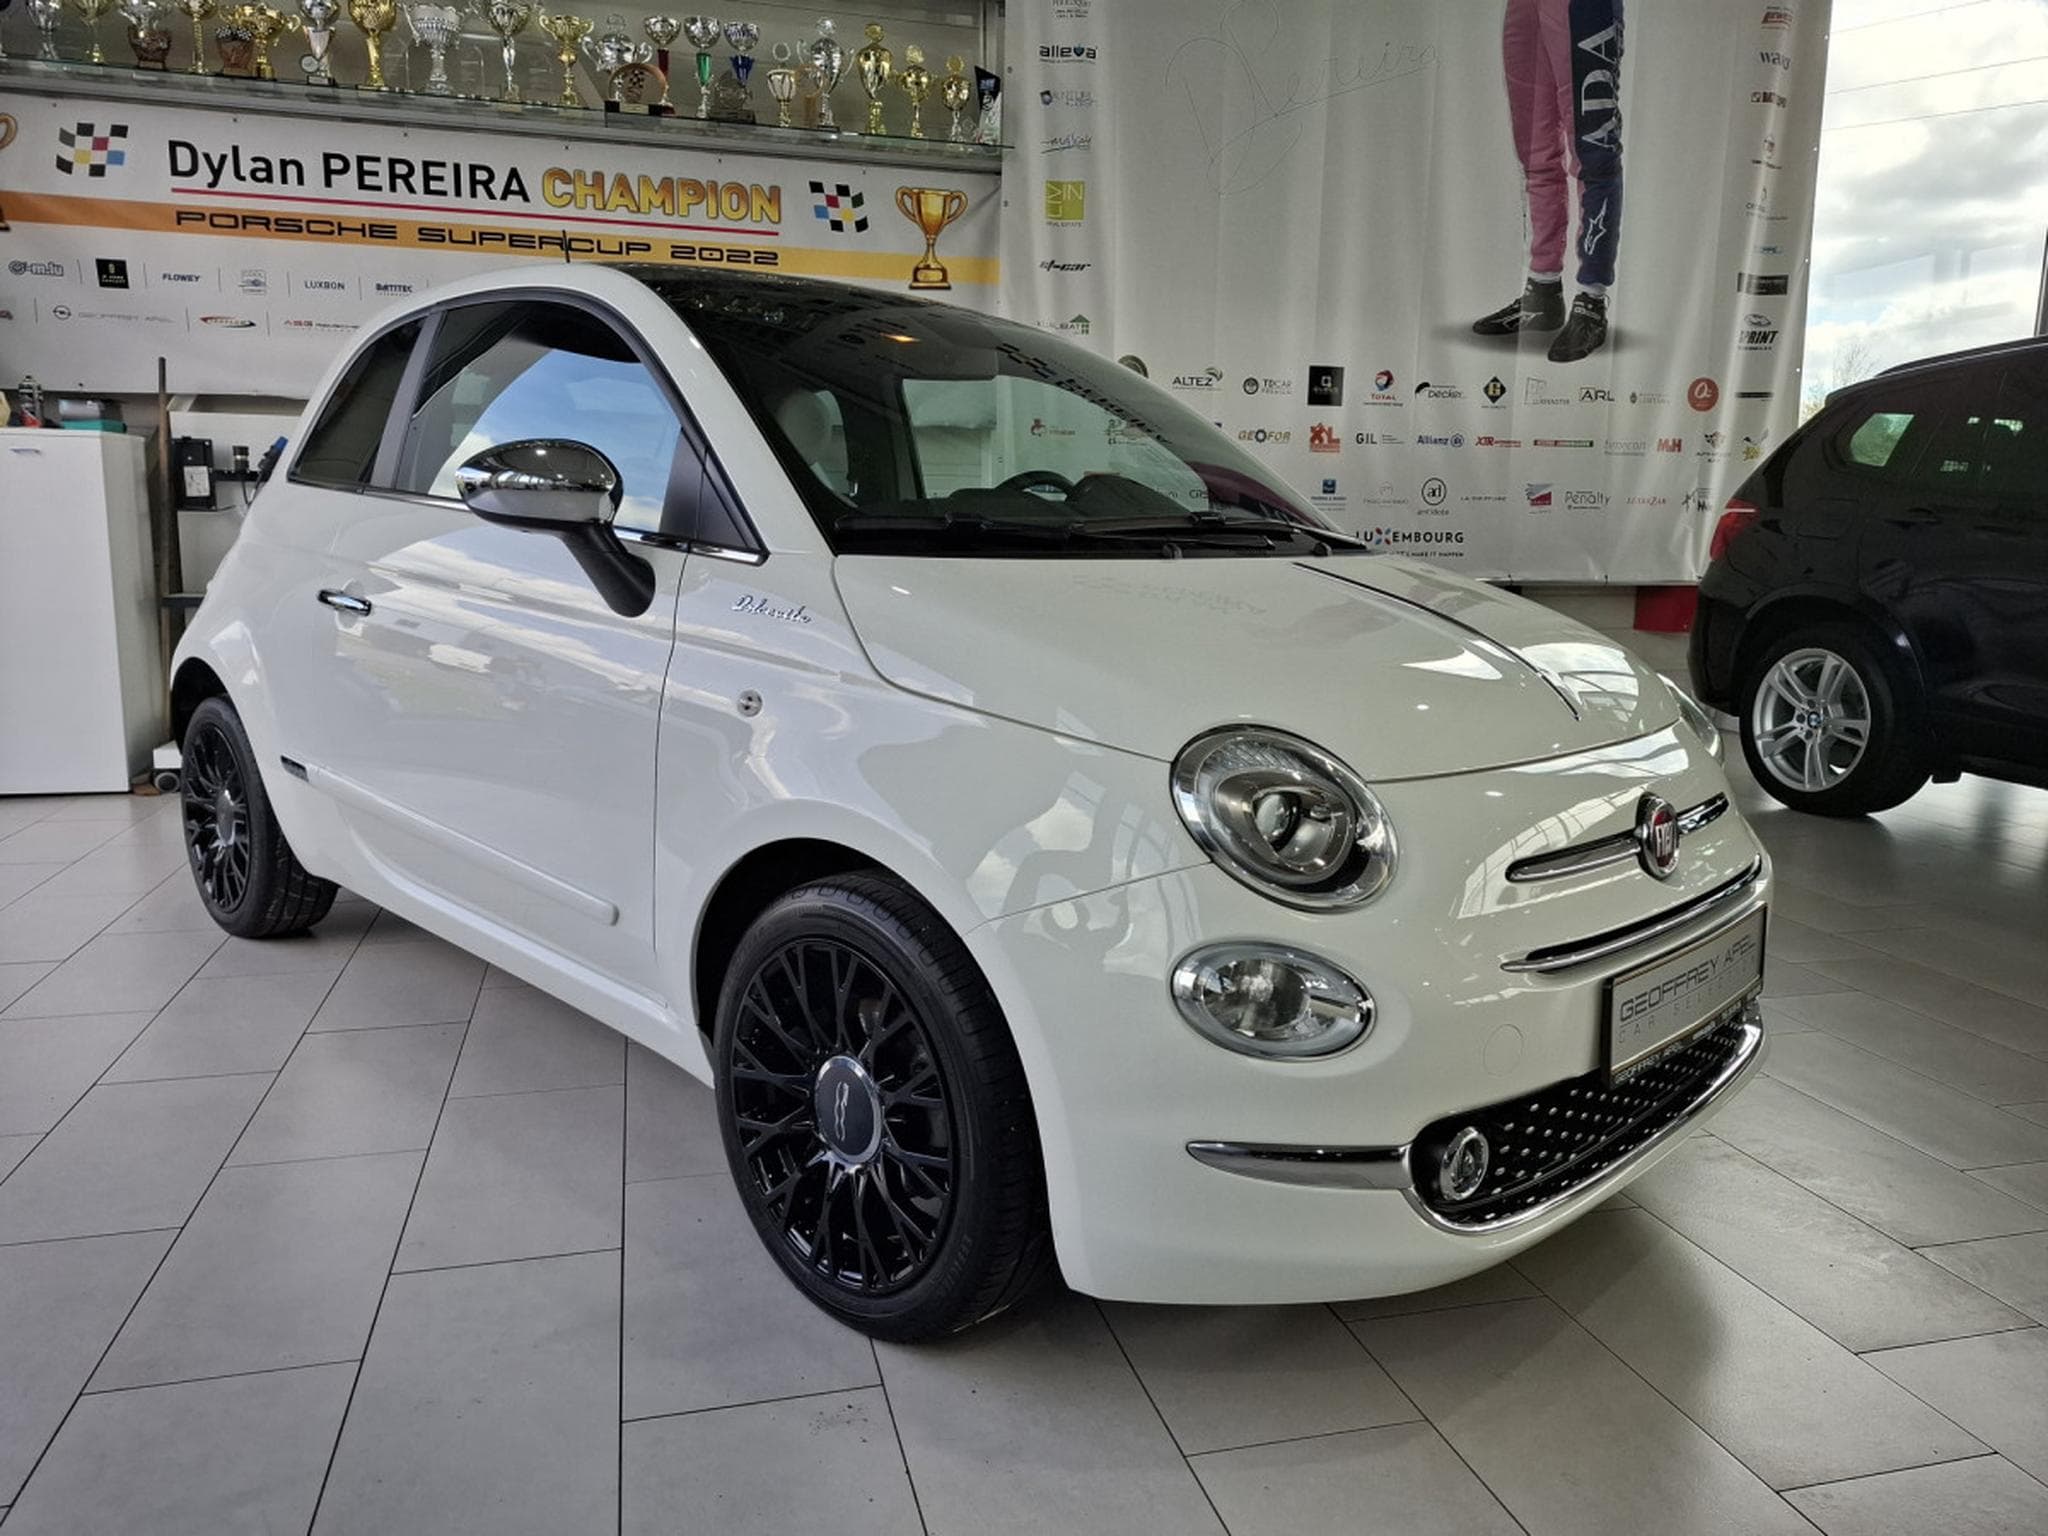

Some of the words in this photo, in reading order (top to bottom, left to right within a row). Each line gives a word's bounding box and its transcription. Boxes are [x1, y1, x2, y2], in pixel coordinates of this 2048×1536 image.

[168, 139, 305, 189] Dylan
[322, 151, 530, 203] PEREIRA
[541, 166, 782, 225] CHAMPION
[175, 209, 399, 241] PORSCHE
[417, 226, 652, 257] SUPERCUP
[670, 243, 780, 266] 2022
[161, 272, 201, 283] FLOWEY
[1172, 377, 1214, 387] ALTEZ
[1580, 389, 1615, 402] ARL
[1238, 428, 1291, 444] GEOFOR
[1356, 432, 1378, 445] GIL
[1417, 434, 1449, 445] Allianz
[1619, 955, 1720, 1023] GEOFFREY
[1723, 934, 1757, 967] APEL
[1618, 1017, 1658, 1044] CAR
[1614, 1053, 1661, 1084] GEOFFREY
